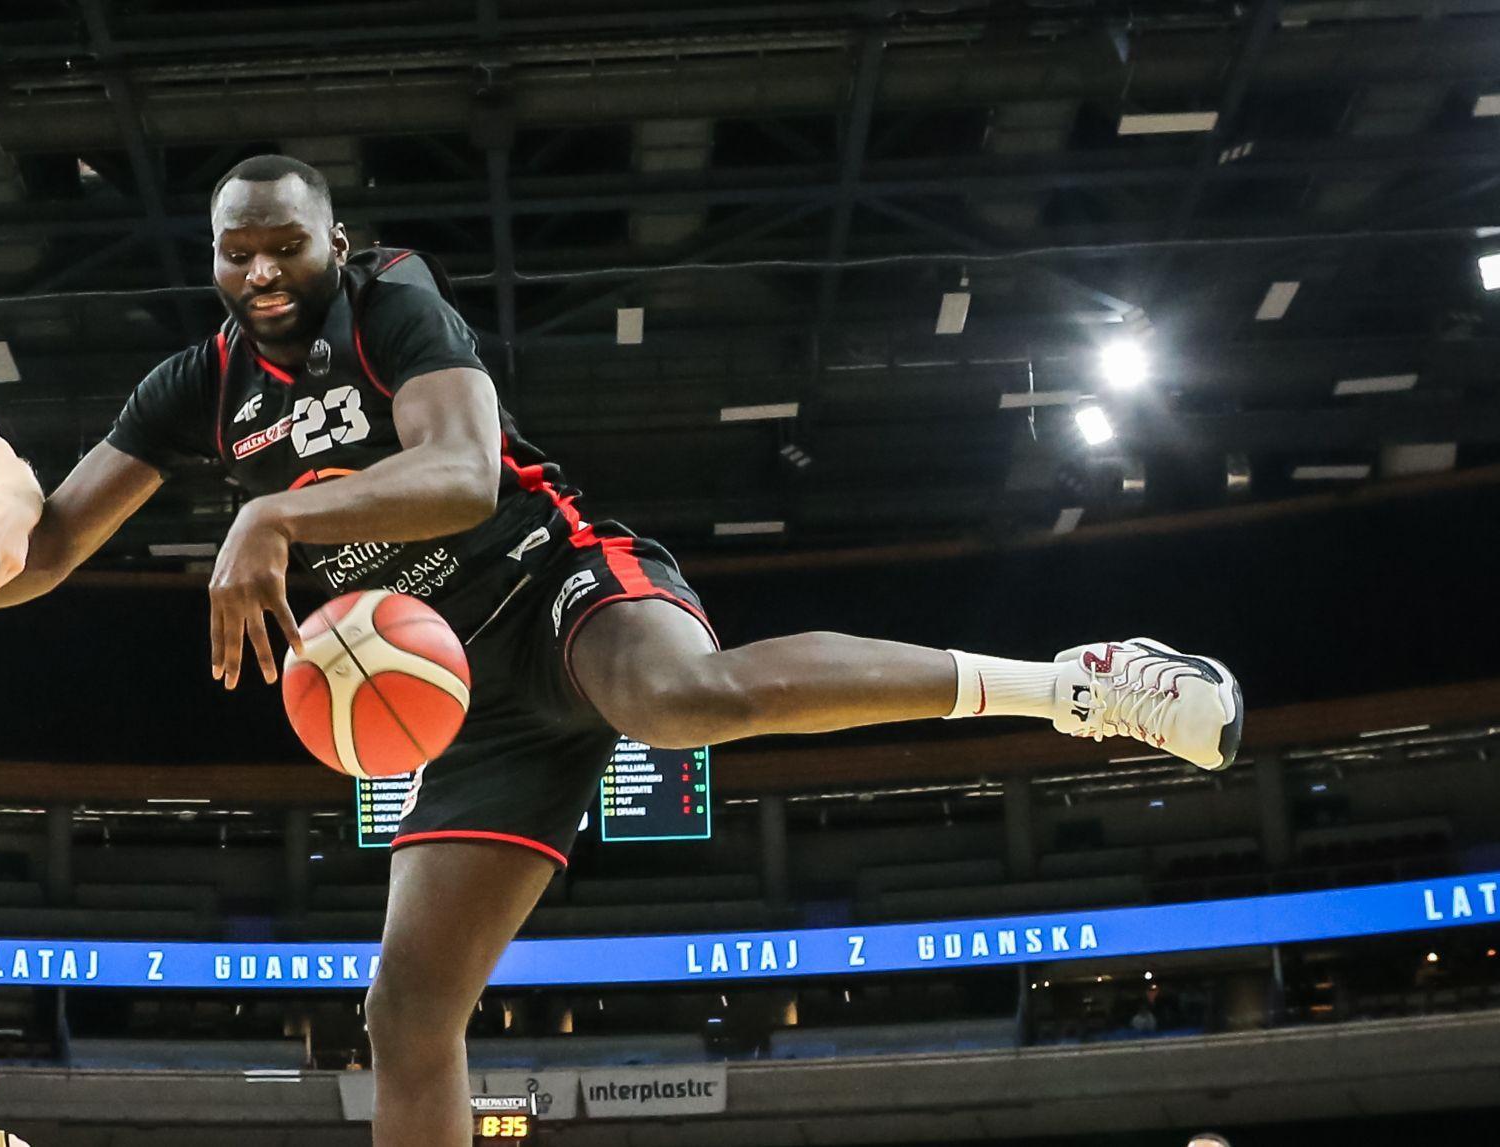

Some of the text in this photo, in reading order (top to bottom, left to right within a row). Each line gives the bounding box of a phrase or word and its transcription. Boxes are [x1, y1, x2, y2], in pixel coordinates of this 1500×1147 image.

[291, 385, 371, 458] 23
[1423, 882, 1497, 921] LAT
[147, 951, 164, 981] Z
[687, 924, 1099, 974] LATAJ Z GDANSKA
[589, 1078, 713, 1104] interplastic
[480, 1115, 529, 1138] 8:35
